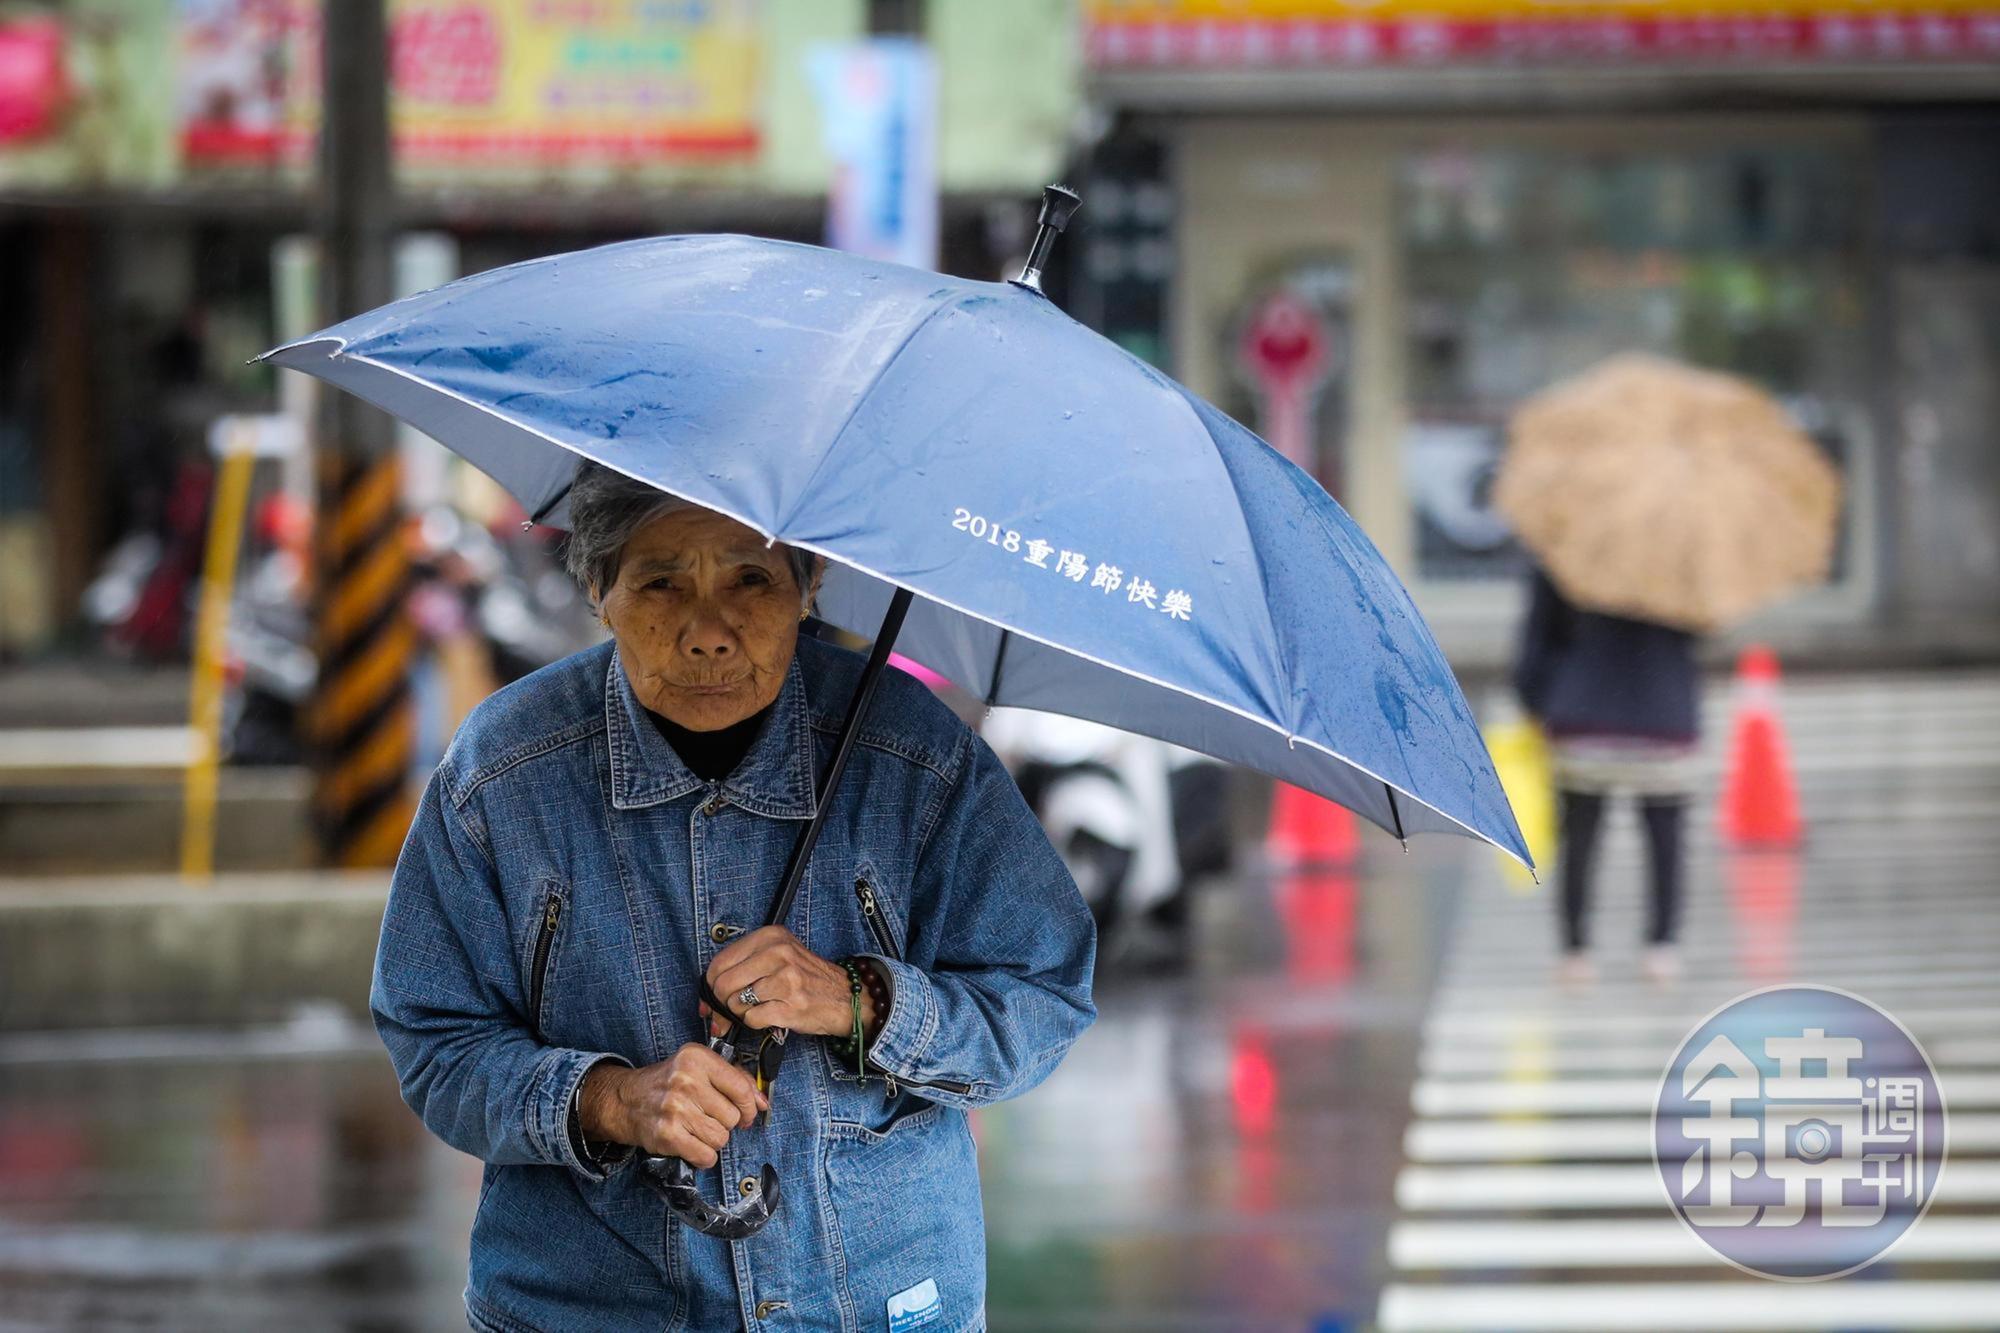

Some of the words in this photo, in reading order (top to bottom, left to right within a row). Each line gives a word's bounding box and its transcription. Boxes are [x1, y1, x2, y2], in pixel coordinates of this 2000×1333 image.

[951, 507, 1193, 621] 2018重陽節快樂
